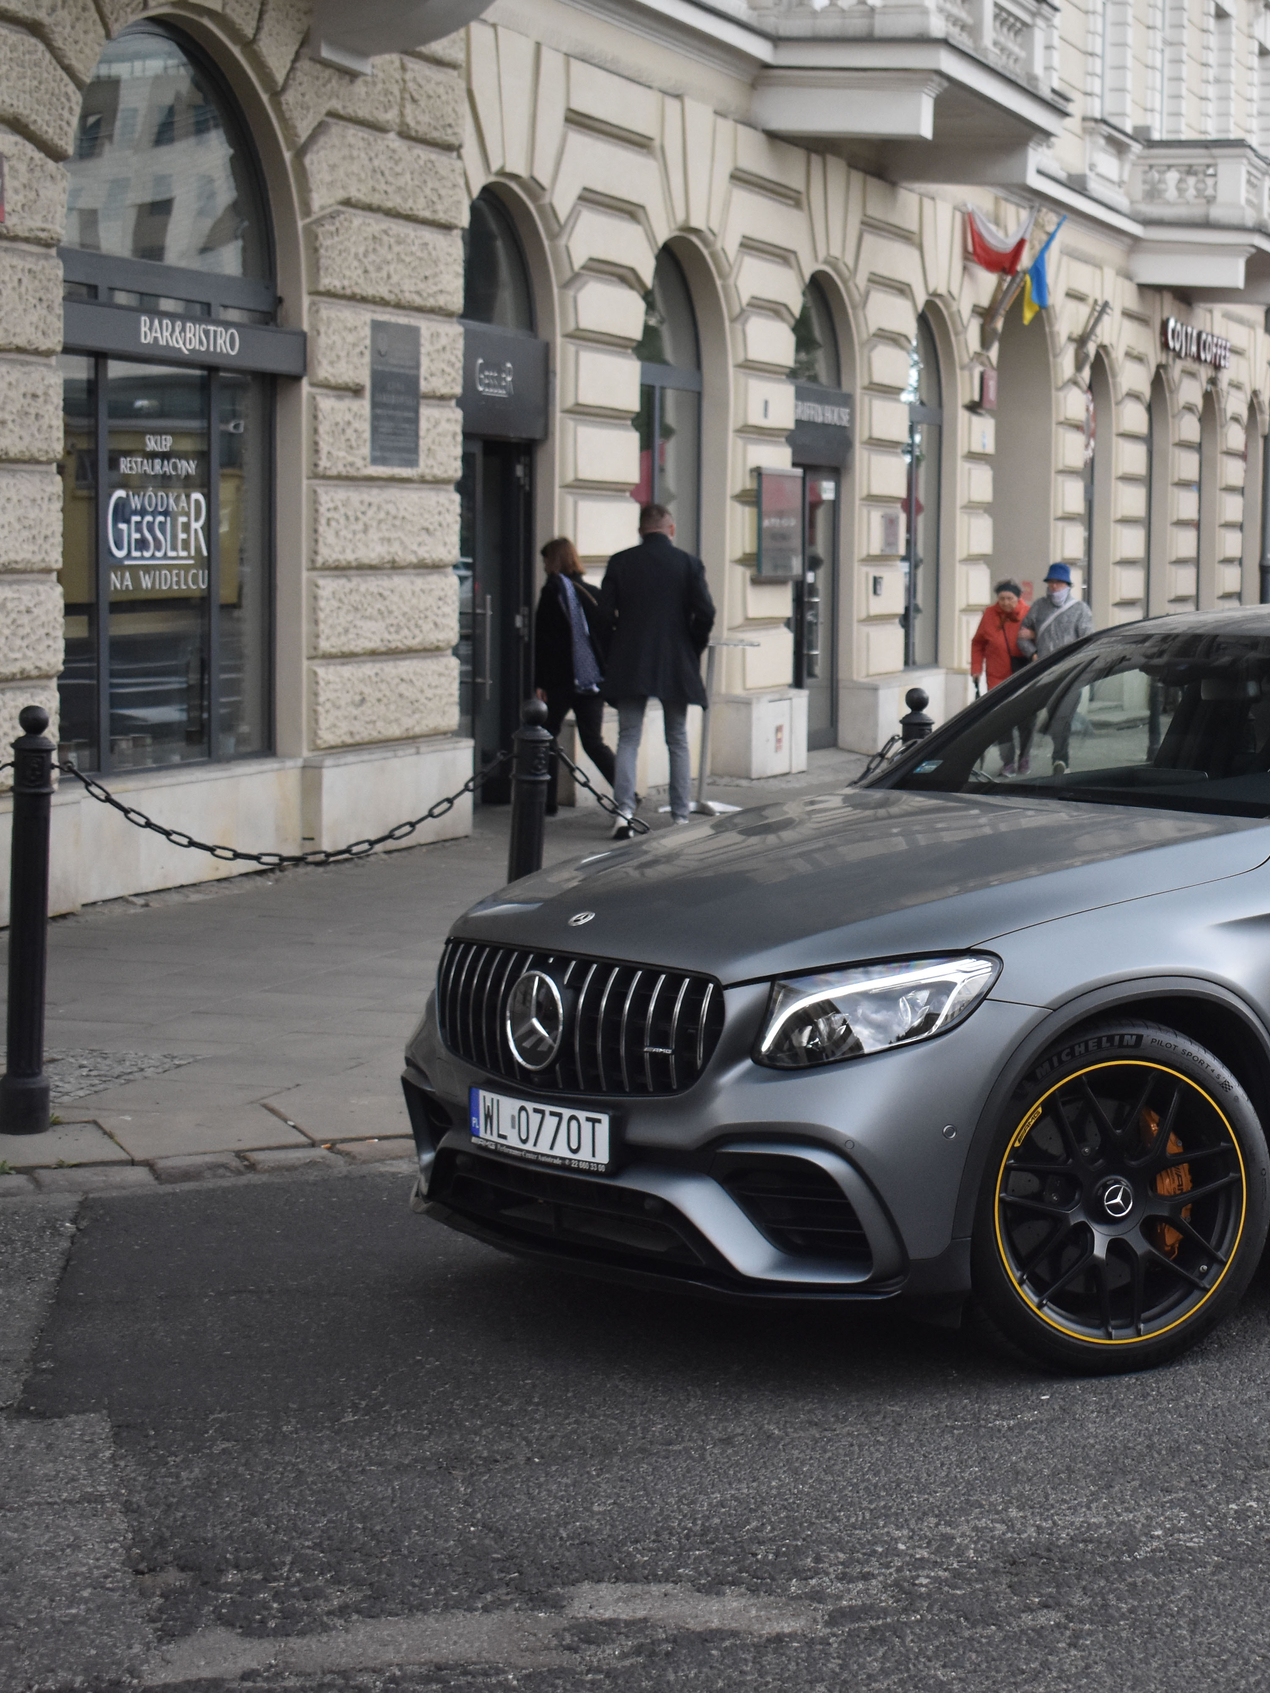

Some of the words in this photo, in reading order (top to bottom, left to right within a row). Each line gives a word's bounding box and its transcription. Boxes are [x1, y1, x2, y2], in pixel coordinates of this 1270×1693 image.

[140, 315, 240, 355] BAR&BISTRO
[1167, 316, 1197, 358] COSTA
[1200, 331, 1230, 369] COFFEE
[145, 434, 173, 451] SKLEP
[119, 456, 197, 479] RESTAURACYJNY
[128, 488, 189, 512] WÓDKA
[108, 489, 208, 559] GESSLER
[110, 570, 133, 591] NA
[139, 569, 208, 590] WIDELCU
[1036, 1034, 1137, 1080] MICHELIN
[1150, 1038, 1179, 1051] PILOT
[1181, 1048, 1211, 1070] SPORT
[472, 1116, 480, 1129] PL
[483, 1095, 508, 1140] WL
[517, 1105, 602, 1158] 0770T
